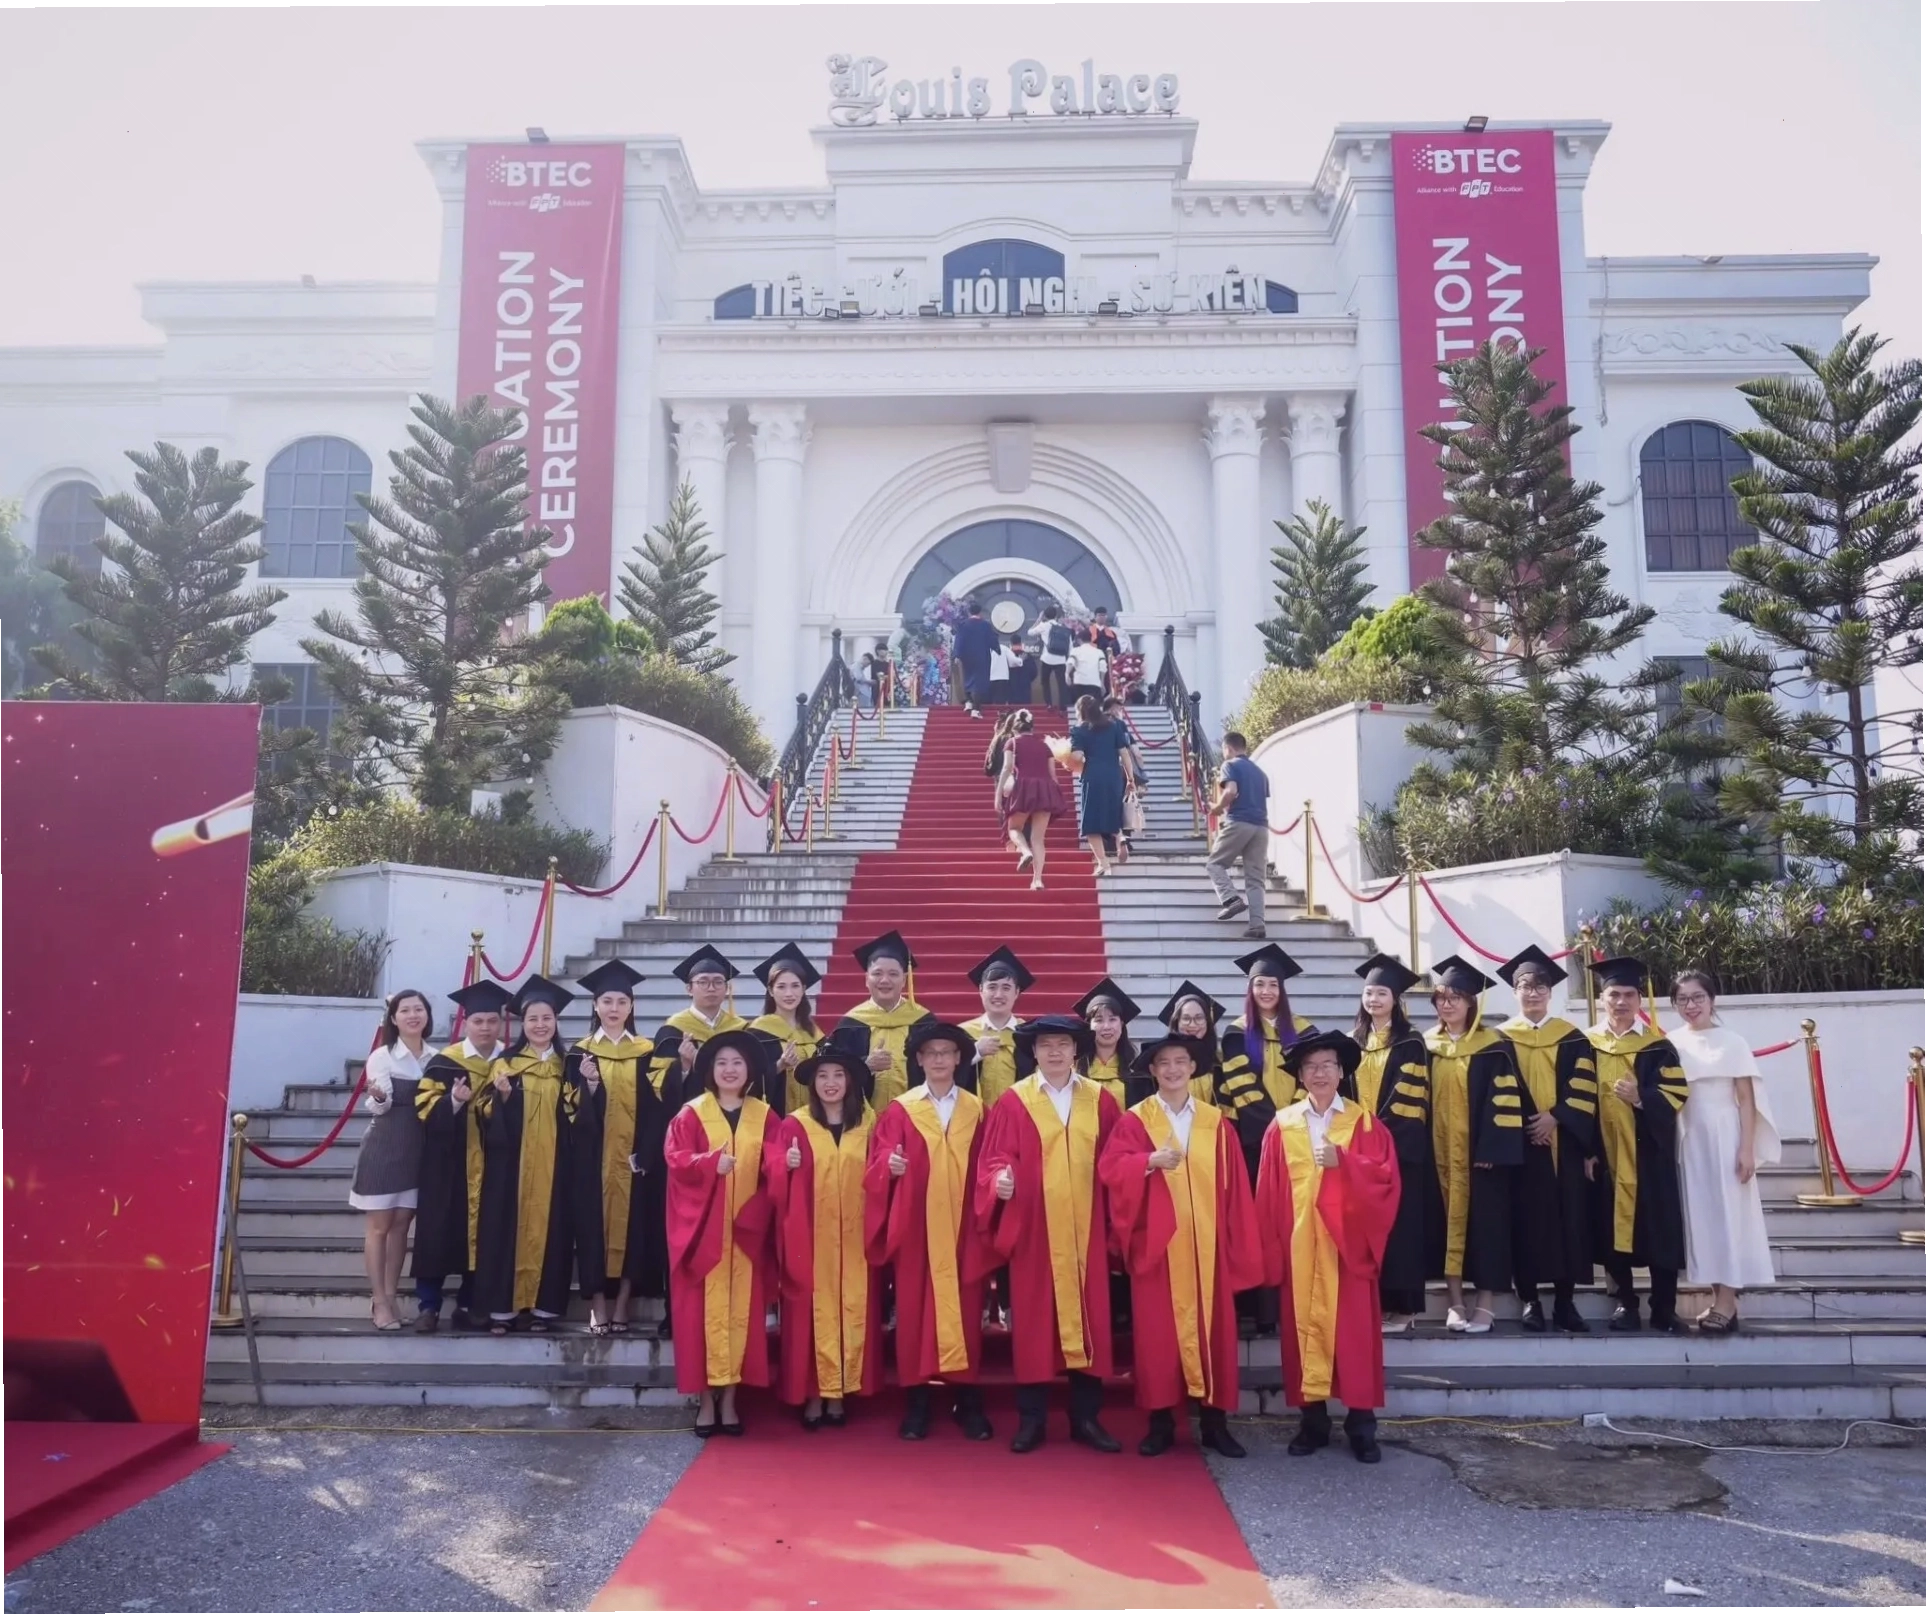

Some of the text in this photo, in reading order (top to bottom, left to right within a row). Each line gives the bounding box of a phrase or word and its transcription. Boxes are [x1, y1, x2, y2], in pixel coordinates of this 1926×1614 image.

[826, 53, 1181, 126] Louis Palace
[505, 161, 592, 188] BTEC
[1434, 148, 1522, 174] BTEC
[1460, 179, 1492, 198] FPT
[1494, 185, 1524, 193] Education
[540, 267, 585, 559] CEREMONY
